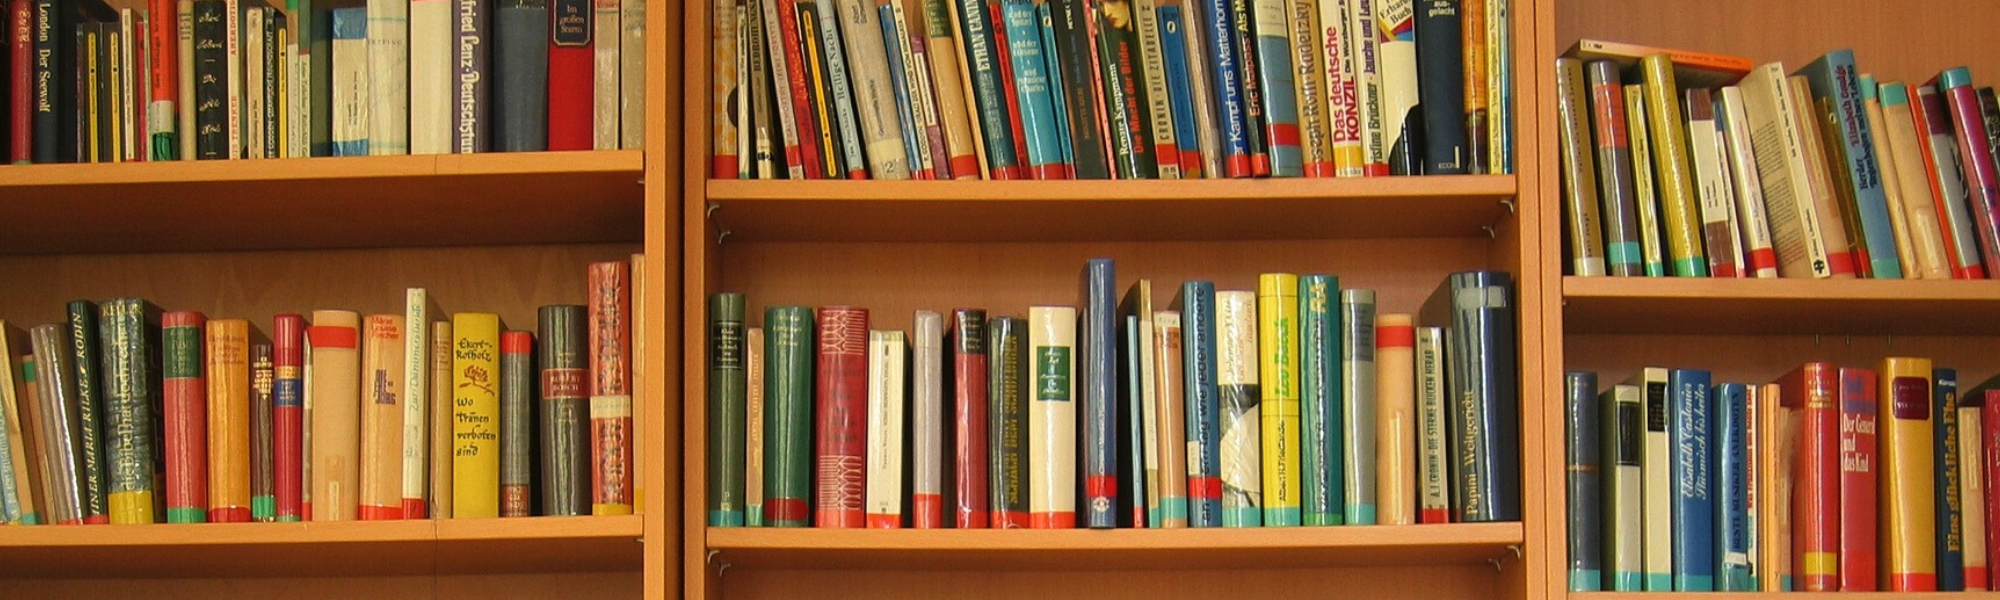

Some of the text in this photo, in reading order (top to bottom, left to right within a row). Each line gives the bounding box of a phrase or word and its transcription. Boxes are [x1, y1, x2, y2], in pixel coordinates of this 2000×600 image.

[750, 0, 761, 72] BEDROHUNGS
[1237, 14, 1249, 32] Als
[1339, 8, 1350, 59] Würzburger
[1361, 18, 1373, 38] und
[39, 4, 51, 113] London Der Seewolf
[825, 28, 838, 60] Nacht
[972, 33, 990, 71] ETHAN
[1242, 37, 1257, 89] Malpass
[831, 62, 845, 100] Heilige
[1119, 41, 1144, 154] Die Macht der Bilder
[1151, 75, 1162, 92] DIE
[1224, 70, 1235, 98] ums
[1325, 27, 1347, 143] Das deutsche
[1156, 101, 1169, 140] CRONIN
[1227, 99, 1241, 142] Kampf
[1249, 91, 1261, 116] Eric
[1343, 76, 1360, 142] KONZIL
[1365, 82, 1380, 129] Brückner
[1116, 121, 1129, 156] Renate
[1842, 100, 1859, 148] Elizabeth
[1195, 288, 1206, 343] andere
[73, 312, 85, 359] RODIN
[1197, 347, 1208, 387] jeder
[1426, 349, 1435, 375] HERAB
[80, 379, 93, 421] RILKE
[457, 397, 473, 407] Wo
[1201, 390, 1209, 416] wie
[1427, 377, 1437, 406] BLICKEN
[1942, 392, 1954, 424] Ehe
[456, 411, 489, 423] Tränen
[457, 424, 496, 440] verboten
[1428, 408, 1438, 436] STERNE
[1843, 413, 1875, 434] Der General
[85, 427, 98, 470] MARIA
[119, 428, 134, 467] Bibel
[456, 442, 479, 456] sind
[1429, 437, 1439, 450] DIE
[1462, 389, 1479, 515] Papini Weltgericht
[1680, 382, 1694, 498] Elisabeth Castonier
[1694, 383, 1706, 500] Stürmisch bis heiter
[1843, 432, 1855, 452] und
[1430, 454, 1440, 483] CRONIN
[1731, 392, 1740, 549] BESTE MUSIKER ANEKDOTEN
[1844, 452, 1868, 472] das Kind
[1944, 426, 1959, 511] glückliche
[1947, 513, 1959, 552] Eine
